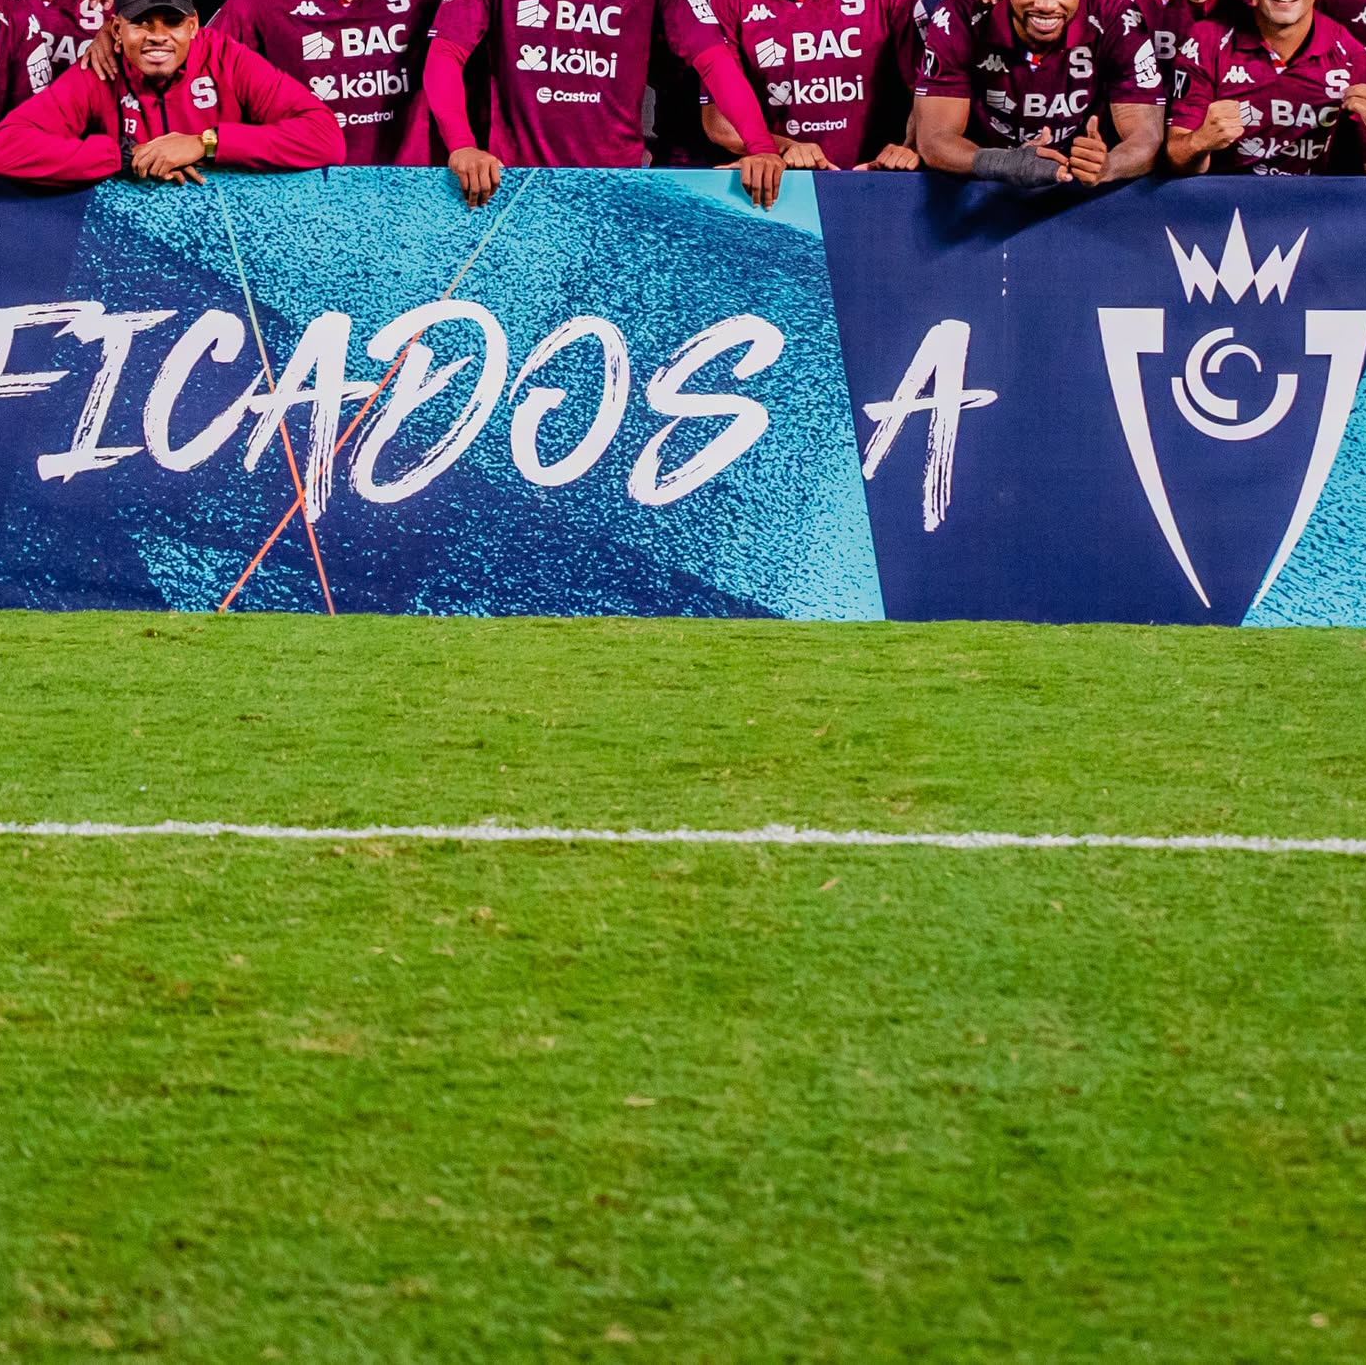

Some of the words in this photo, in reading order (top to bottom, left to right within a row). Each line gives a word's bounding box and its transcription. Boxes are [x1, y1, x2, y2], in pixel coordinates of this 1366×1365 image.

[555, 0, 621, 36] BAC
[341, 24, 408, 57] BAC
[792, 27, 862, 62] BAC
[551, 47, 618, 78] kölbi
[1069, 46, 1093, 79] S
[190, 76, 217, 109] S
[341, 68, 409, 99] kölbi
[553, 90, 601, 103] Castrol
[793, 74, 864, 104] kölbi
[348, 110, 394, 125] Castrol
[1023, 89, 1089, 118] BAC
[1271, 99, 1339, 128] BAC
[124, 117, 137, 134] 13
[801, 118, 847, 133] Castrol
[861, 318, 997, 532] A
